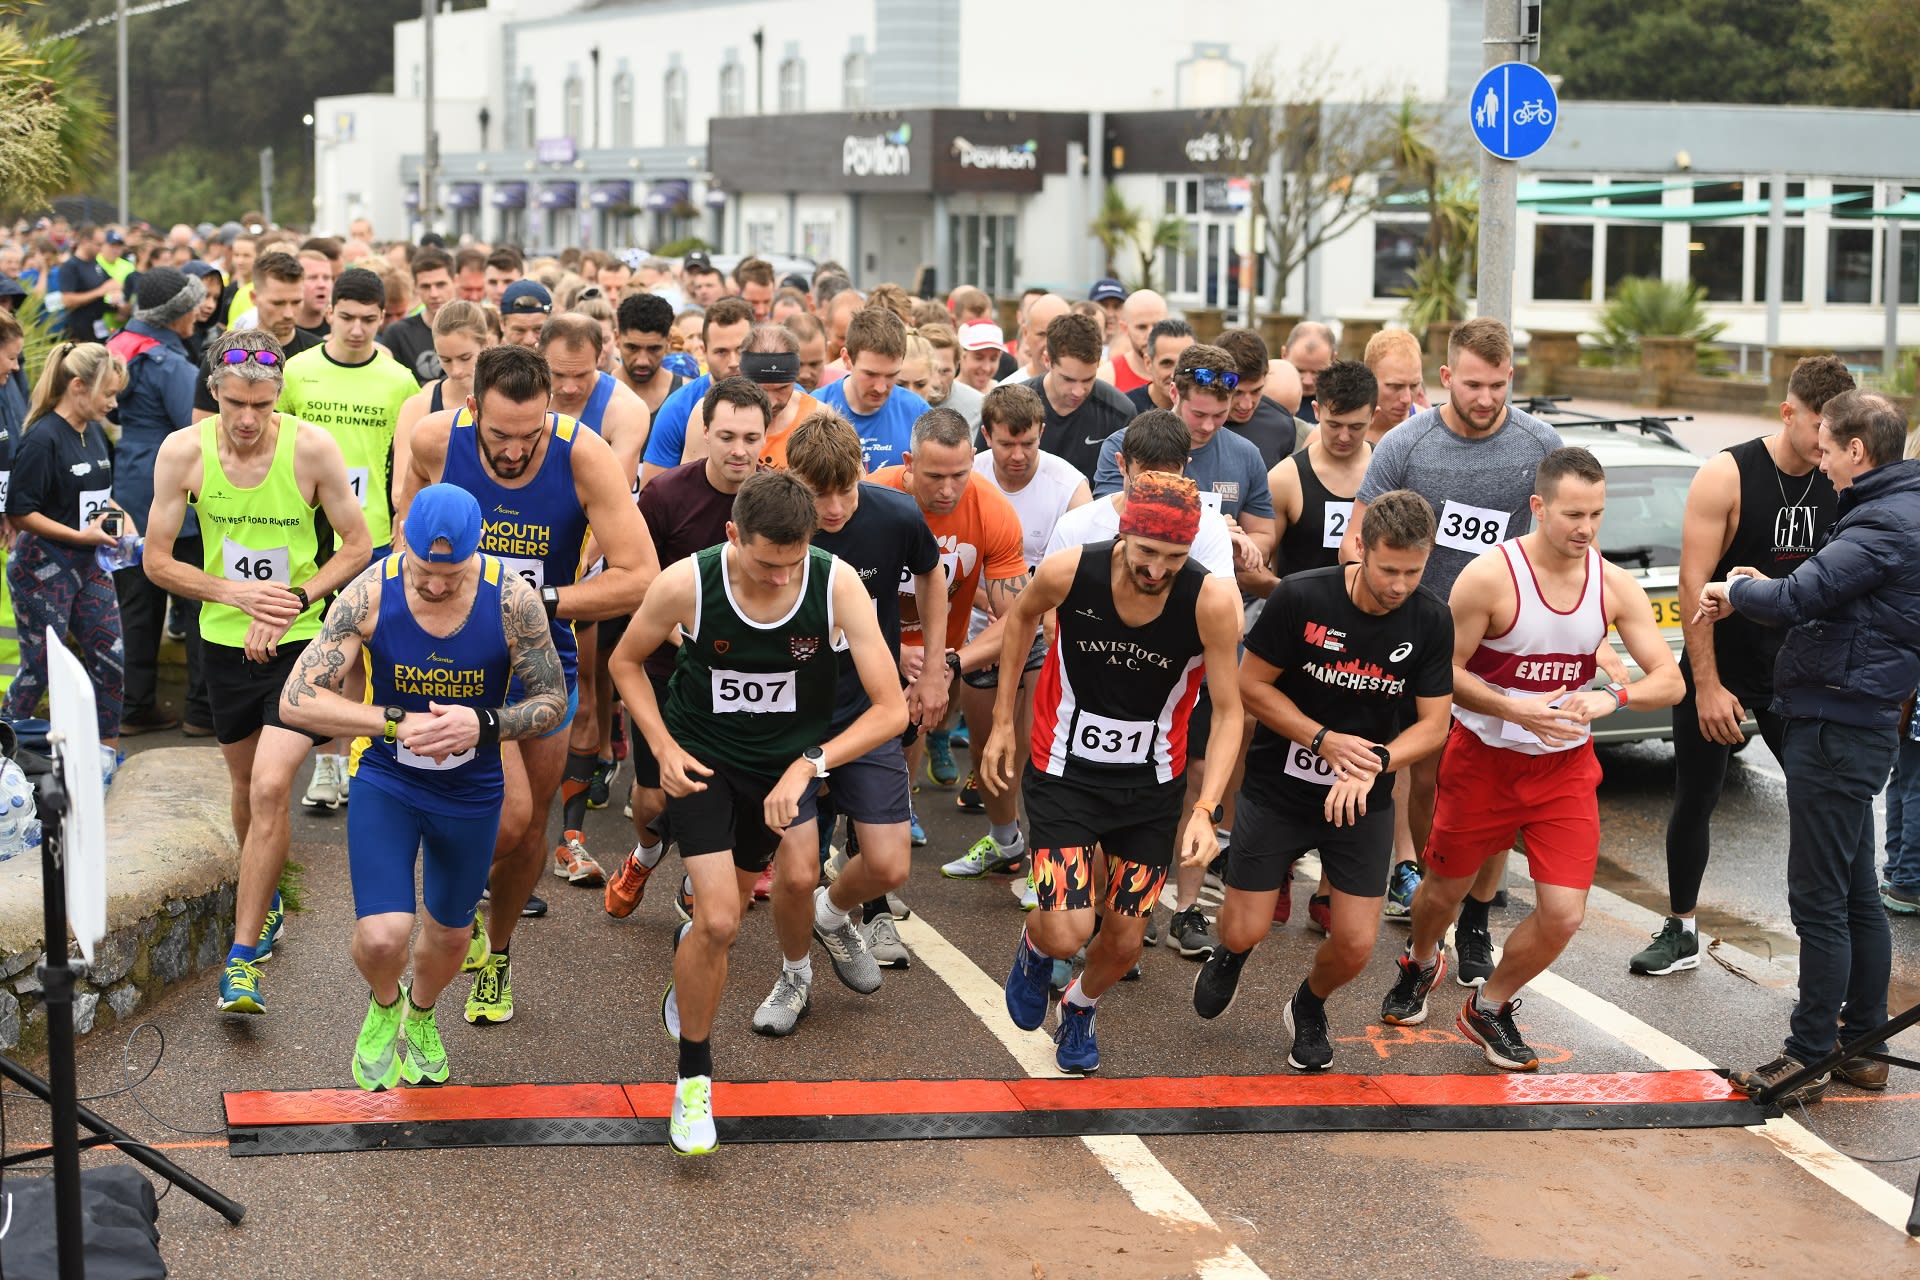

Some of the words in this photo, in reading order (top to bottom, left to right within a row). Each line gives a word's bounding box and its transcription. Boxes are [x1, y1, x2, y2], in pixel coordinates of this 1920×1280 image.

[307, 400, 347, 412] SOUTH
[352, 404, 385, 416] WEST
[302, 412, 332, 423] ROAD
[336, 416, 388, 428] RUNNERS
[247, 516, 268, 525] ROAD
[481, 518, 550, 541] MOUTH
[1443, 513, 1500, 545] 398
[234, 556, 273, 581] 46
[1076, 640, 1174, 670] TAVISTOCK
[1106, 654, 1122, 665] A.
[1126, 658, 1141, 671] C.
[394, 663, 485, 684] EXMOUTH
[1302, 661, 1406, 695] MANCHESTER
[1515, 661, 1583, 682] EXETER
[395, 679, 485, 698] HARRIERS
[719, 678, 788, 703] 507
[1081, 725, 1143, 754] 631
[1294, 747, 1345, 777] 60
